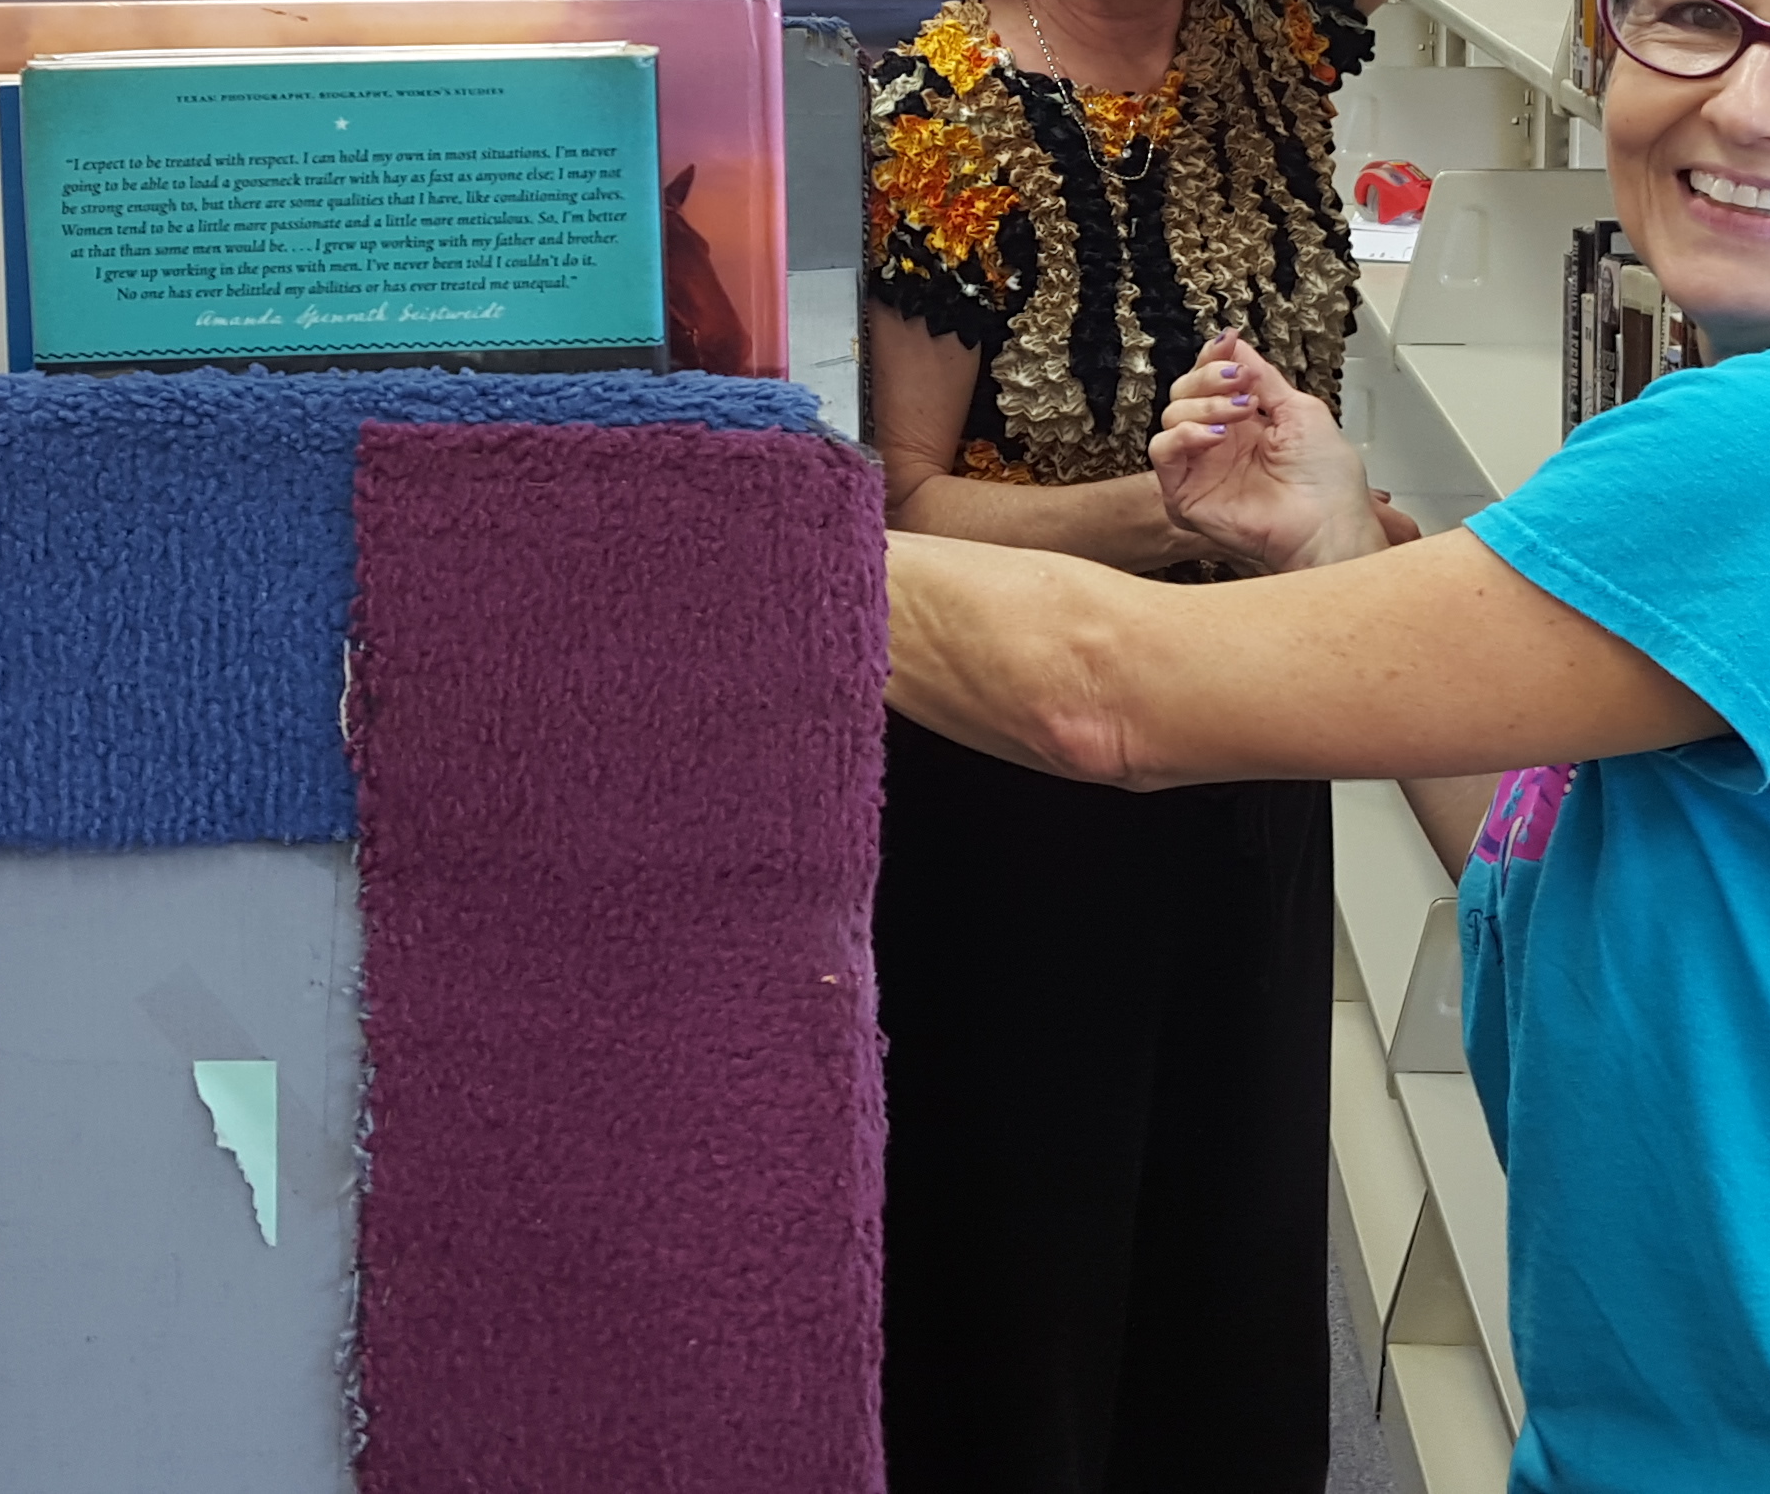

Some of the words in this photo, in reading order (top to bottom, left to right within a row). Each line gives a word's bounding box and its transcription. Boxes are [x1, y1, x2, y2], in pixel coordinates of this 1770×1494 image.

[82, 159, 125, 173] expect
[165, 153, 212, 167] treated
[214, 152, 245, 165] with
[312, 155, 335, 163] can
[339, 148, 369, 162] hold
[395, 152, 425, 161] own
[445, 149, 477, 161] most
[581, 147, 618, 156] never
[61, 178, 102, 196] going
[140, 176, 169, 189] able
[189, 175, 219, 188] load
[232, 172, 301, 191] gooseneck
[304, 172, 346, 185] trailer
[349, 170, 380, 184] with
[382, 170, 408, 187] hay
[427, 169, 454, 186] fast
[475, 172, 523, 184] anyone
[567, 170, 594, 182] may
[597, 168, 622, 178] not
[80, 201, 124, 217] strong
[127, 198, 177, 215] enough
[202, 196, 224, 210] but
[228, 196, 262, 209] there
[265, 199, 286, 208] are
[290, 198, 324, 208] some
[327, 193, 384, 211] qualities
[386, 192, 415, 205] that
[466, 190, 491, 203] like
[494, 189, 578, 206] conditioning
[61, 222, 114, 235] Women
[114, 220, 147, 234] tend
[198, 218, 230, 232] little
[234, 222, 267, 231] more
[270, 217, 342, 234] passionate
[345, 214, 371, 227] and
[386, 213, 417, 226] little
[420, 217, 454, 226] more
[588, 209, 627, 222] better
[88, 244, 116, 257] that
[120, 243, 152, 256] than
[154, 246, 189, 255] some
[192, 245, 222, 254] men
[224, 239, 266, 253] would
[322, 241, 357, 254] grew
[380, 235, 435, 252] working
[438, 234, 468, 246] with
[492, 232, 536, 250] father
[538, 231, 564, 244] and
[103, 269, 138, 283] grew
[160, 263, 217, 280] working
[237, 261, 259, 274] the
[262, 264, 293, 278] pens
[296, 259, 327, 272] with
[393, 261, 430, 270] never
[430, 256, 463, 269] been
[466, 254, 494, 268] told
[140, 290, 165, 299] one
[168, 285, 192, 297] has
[195, 288, 223, 297] ever
[226, 281, 281, 296] belittled
[308, 280, 362, 293] abilities
[383, 279, 407, 292] has
[410, 282, 438, 291] ever
[441, 276, 486, 290] treated
